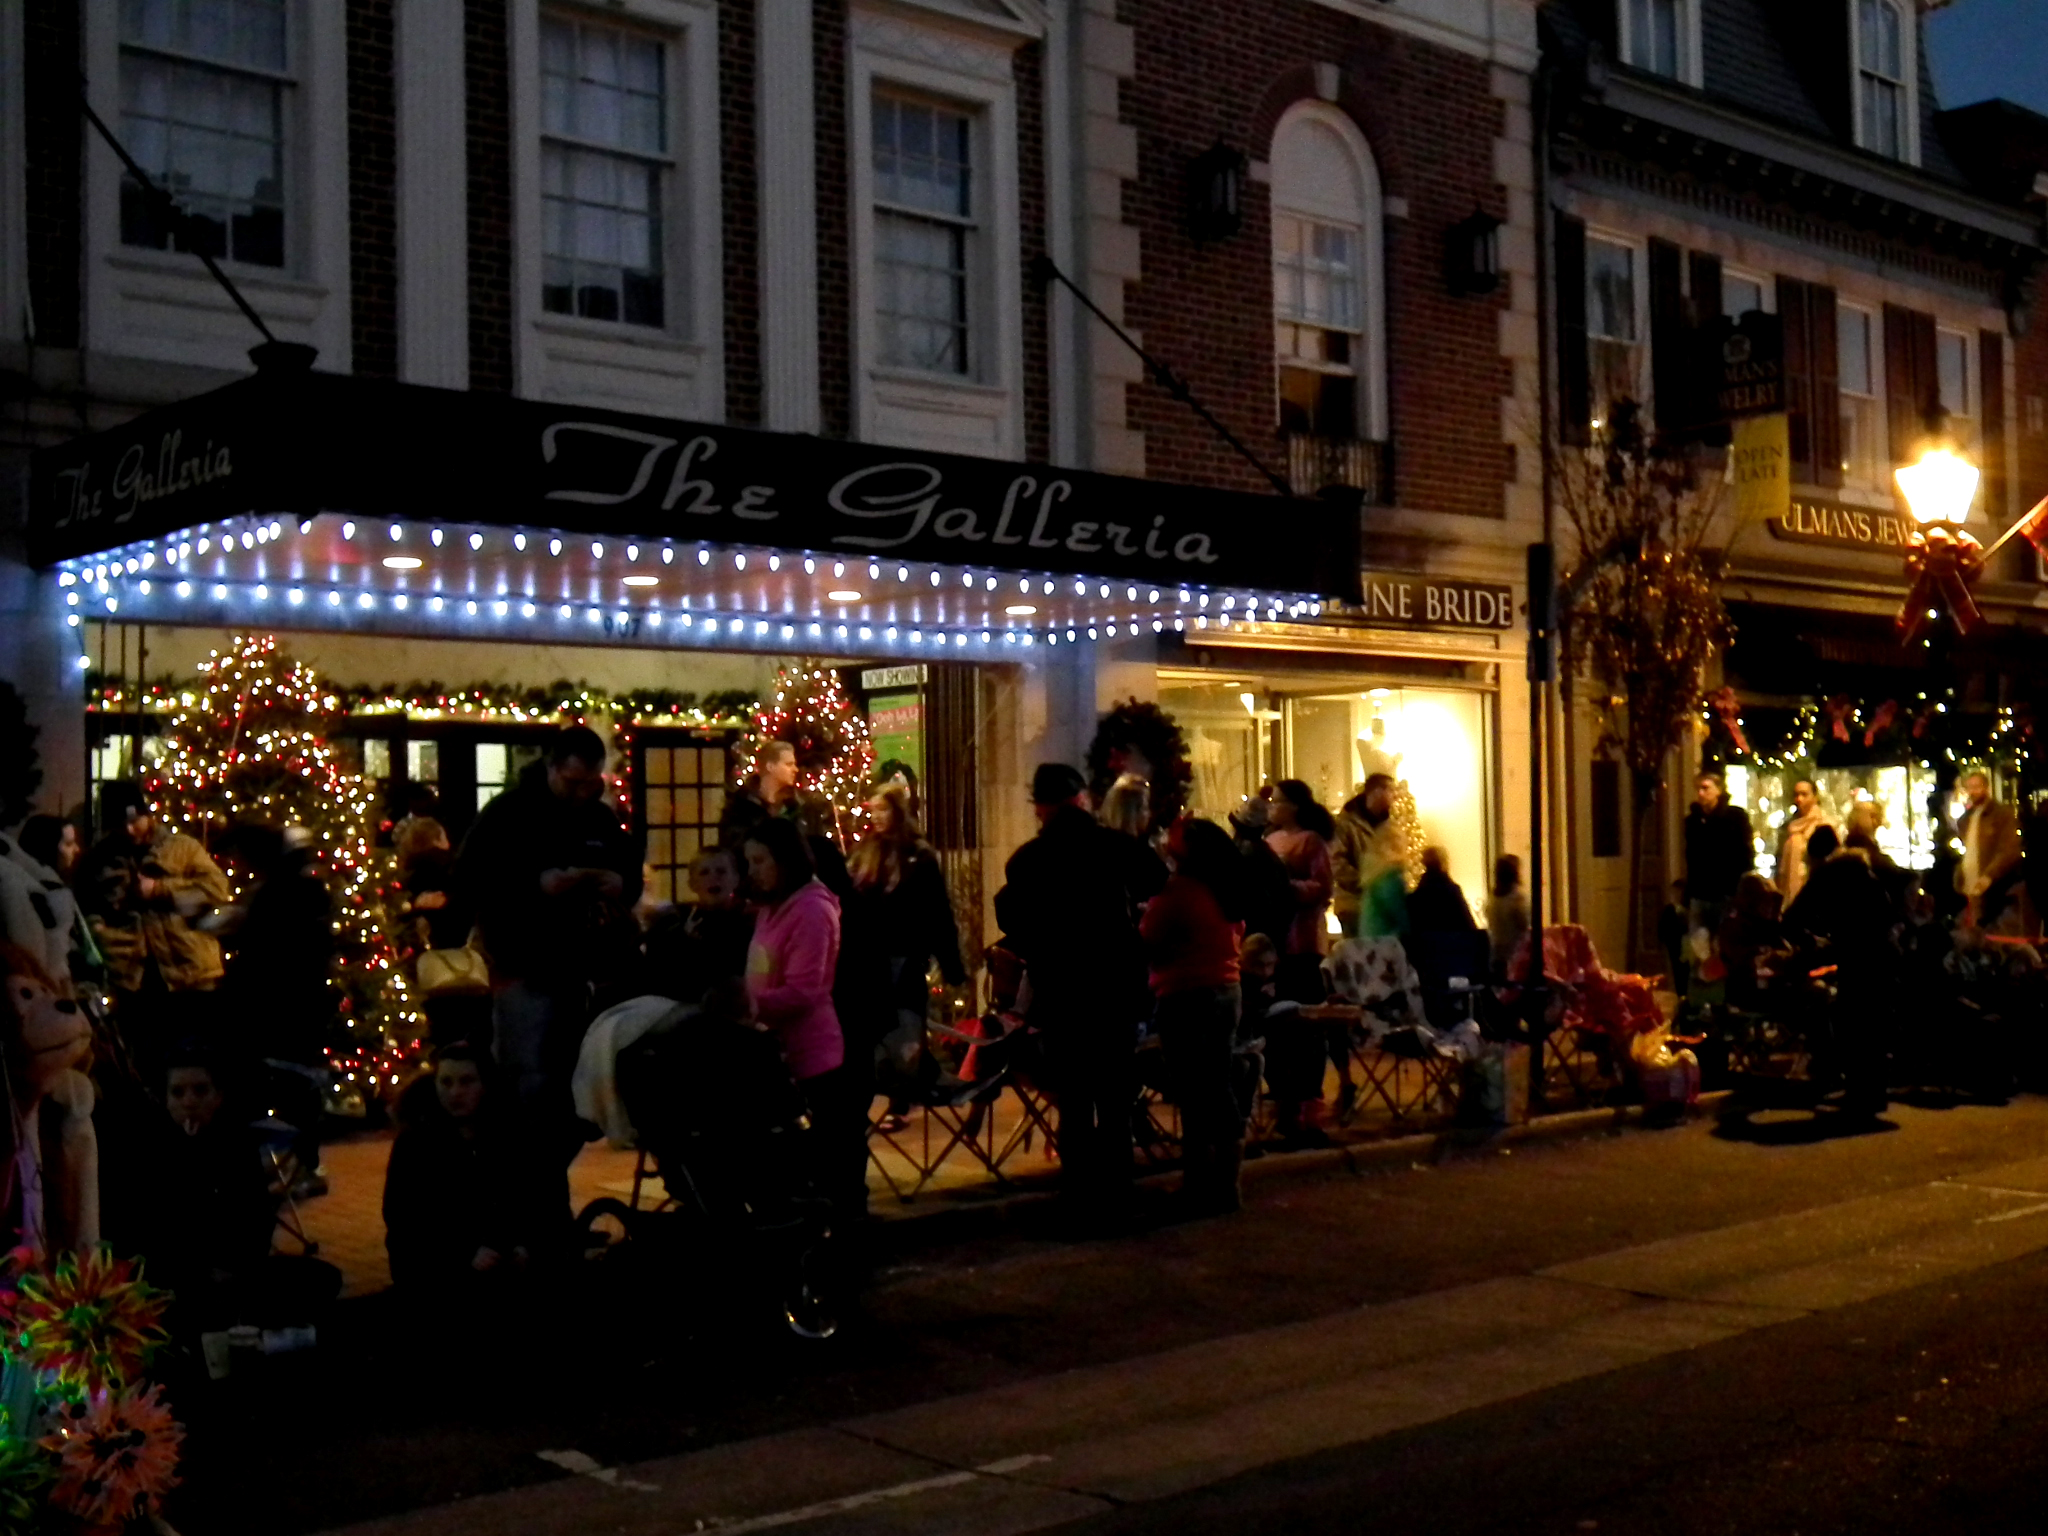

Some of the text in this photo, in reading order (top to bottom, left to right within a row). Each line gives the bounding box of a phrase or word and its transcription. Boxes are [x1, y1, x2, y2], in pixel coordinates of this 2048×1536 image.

[1724, 357, 1779, 383] MAN'S
[1716, 382, 1778, 411] WELRY
[1735, 444, 1784, 465] OPEN
[53, 428, 234, 531] The Galleria
[541, 421, 1220, 566] The Galleria
[1426, 584, 1514, 627] BRIDE
